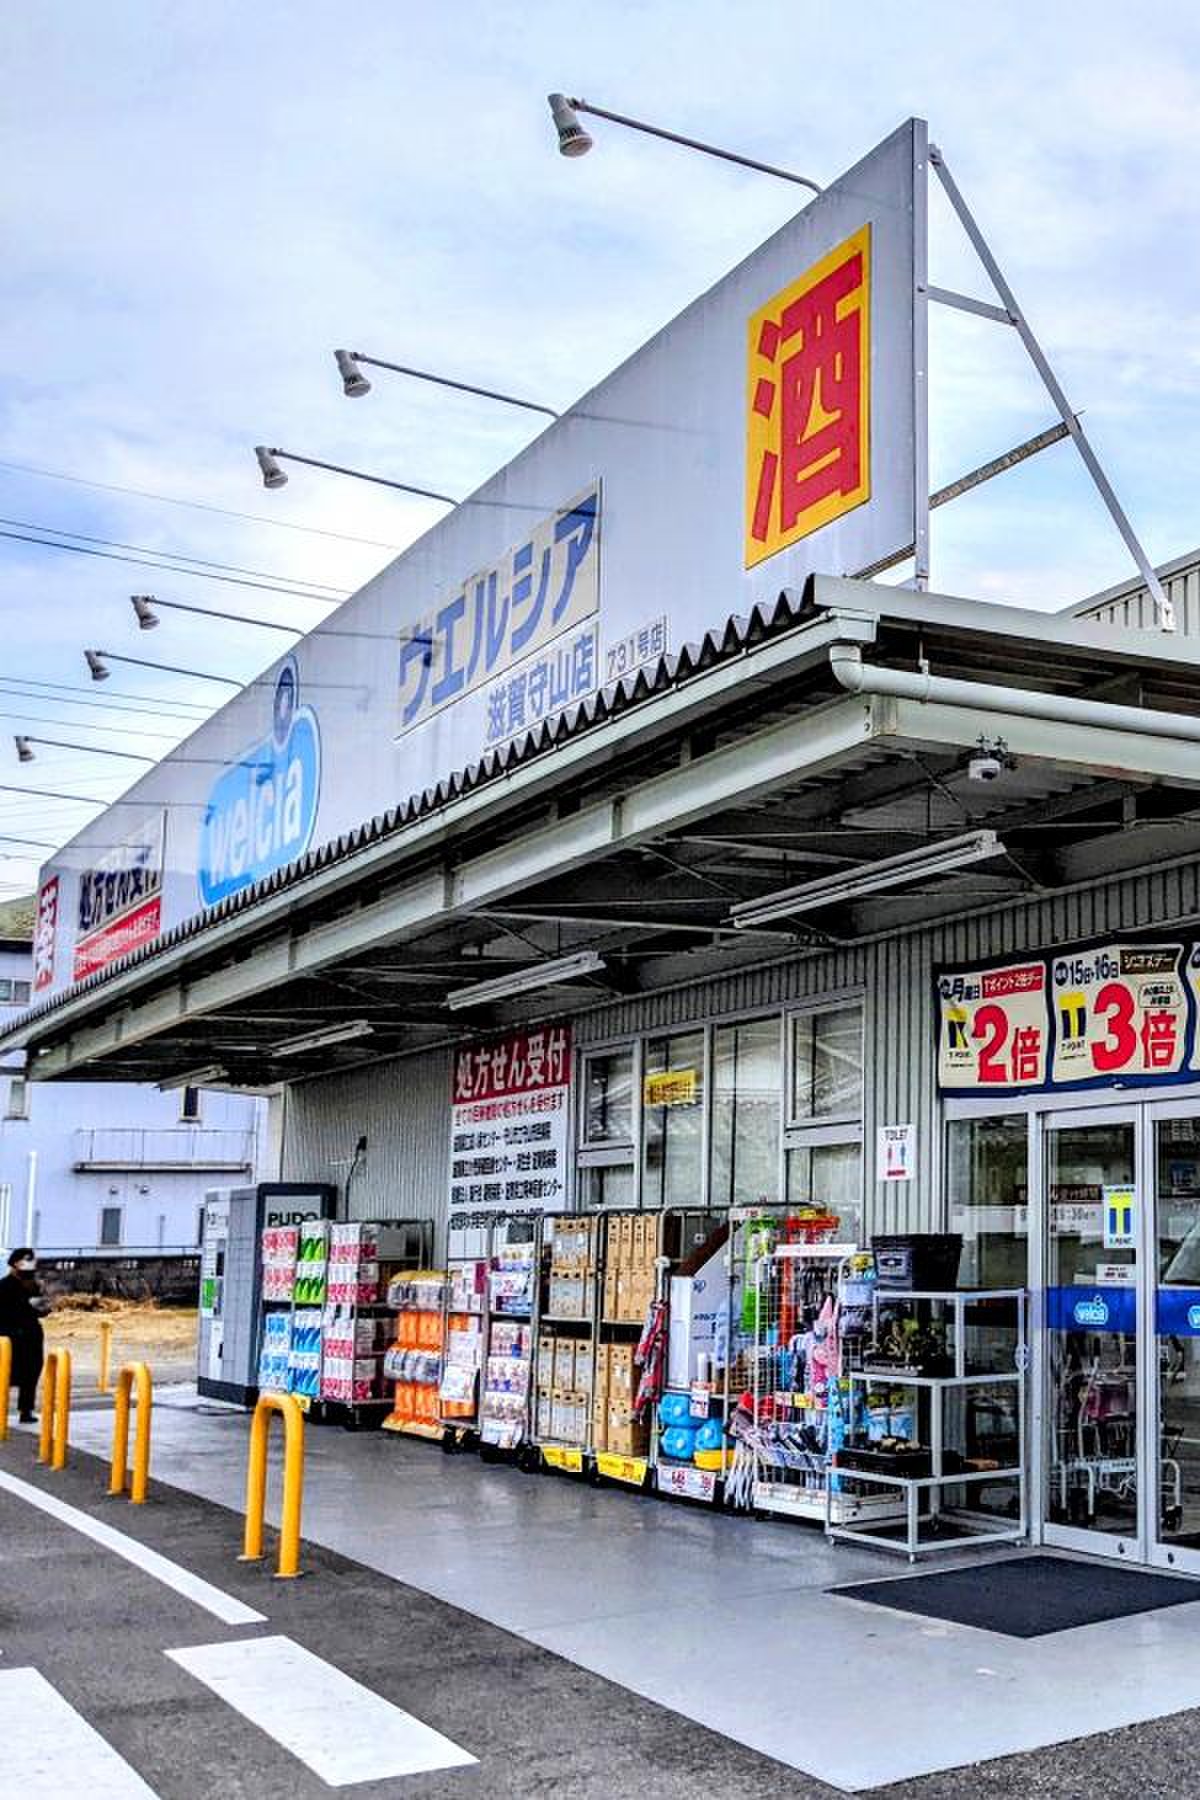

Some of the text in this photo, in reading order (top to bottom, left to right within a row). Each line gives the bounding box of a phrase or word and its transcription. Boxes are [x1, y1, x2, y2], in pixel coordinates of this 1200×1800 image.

[752, 251, 863, 542] 酒
[400, 493, 598, 727] ウエルシア
[607, 623, 664, 677] 731号店
[488, 633, 594, 741] 滋賀守山店
[208, 757, 304, 888] welcia
[455, 1028, 567, 1099] 処方せん受付
[267, 1211, 318, 1227] PUDO
